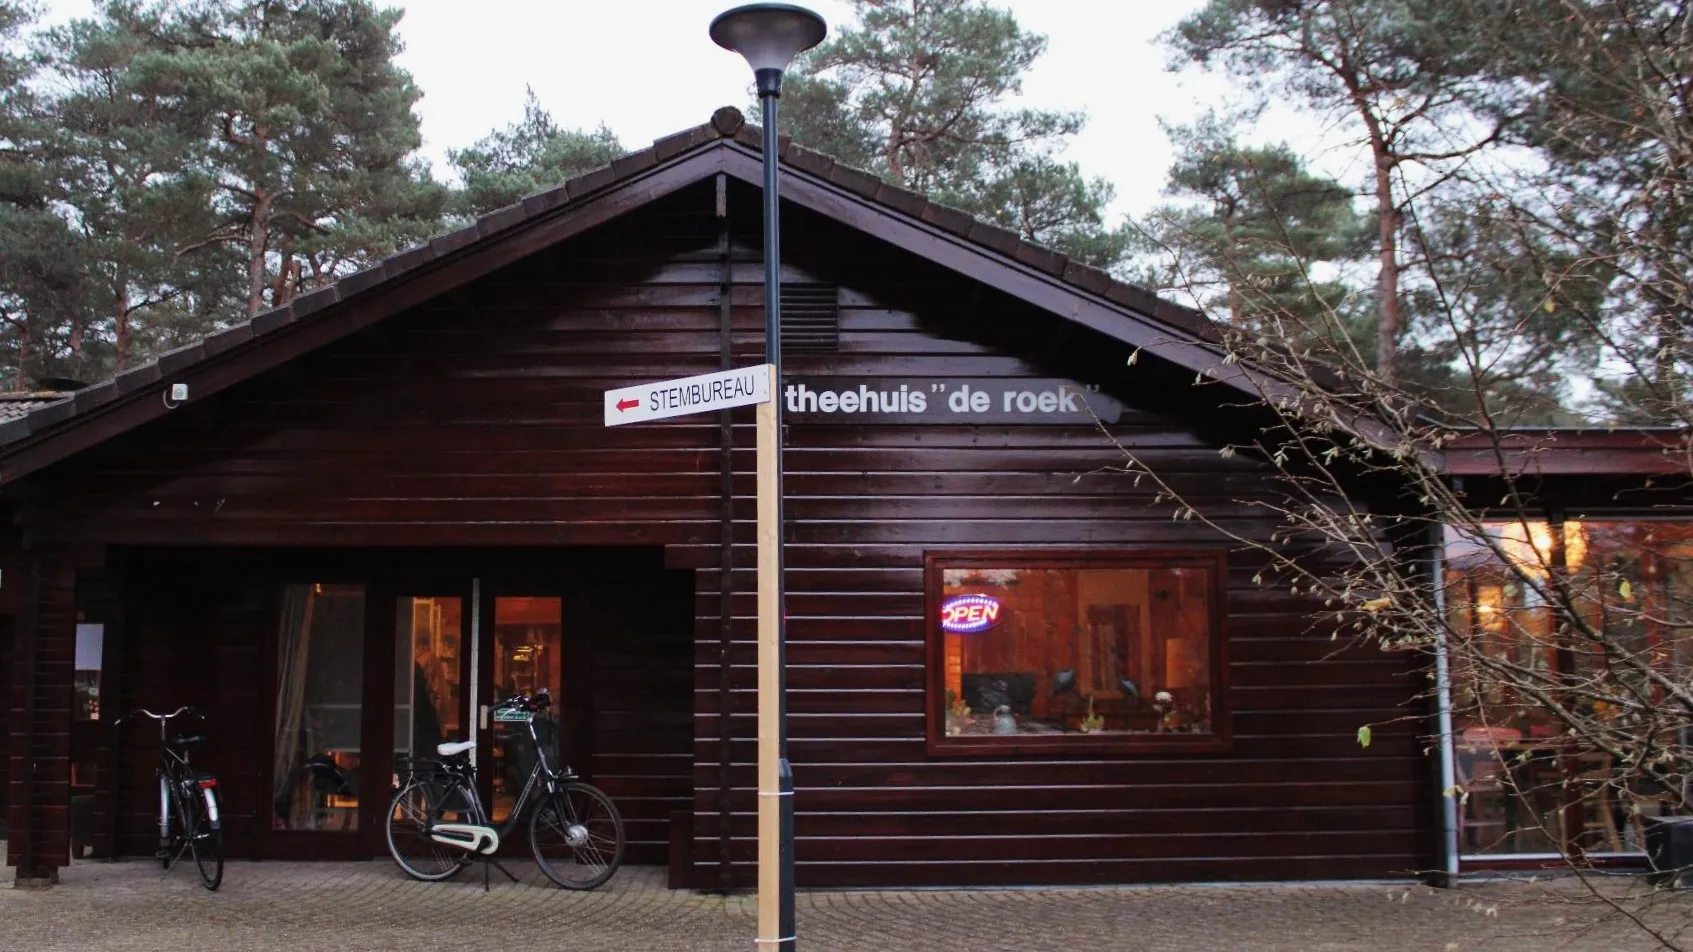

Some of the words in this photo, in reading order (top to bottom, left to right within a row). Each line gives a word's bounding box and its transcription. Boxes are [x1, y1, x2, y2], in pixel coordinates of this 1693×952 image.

[650, 375, 755, 412] STEMBUREAU
[784, 383, 928, 413] theehuis
[942, 604, 999, 622] OPEN
